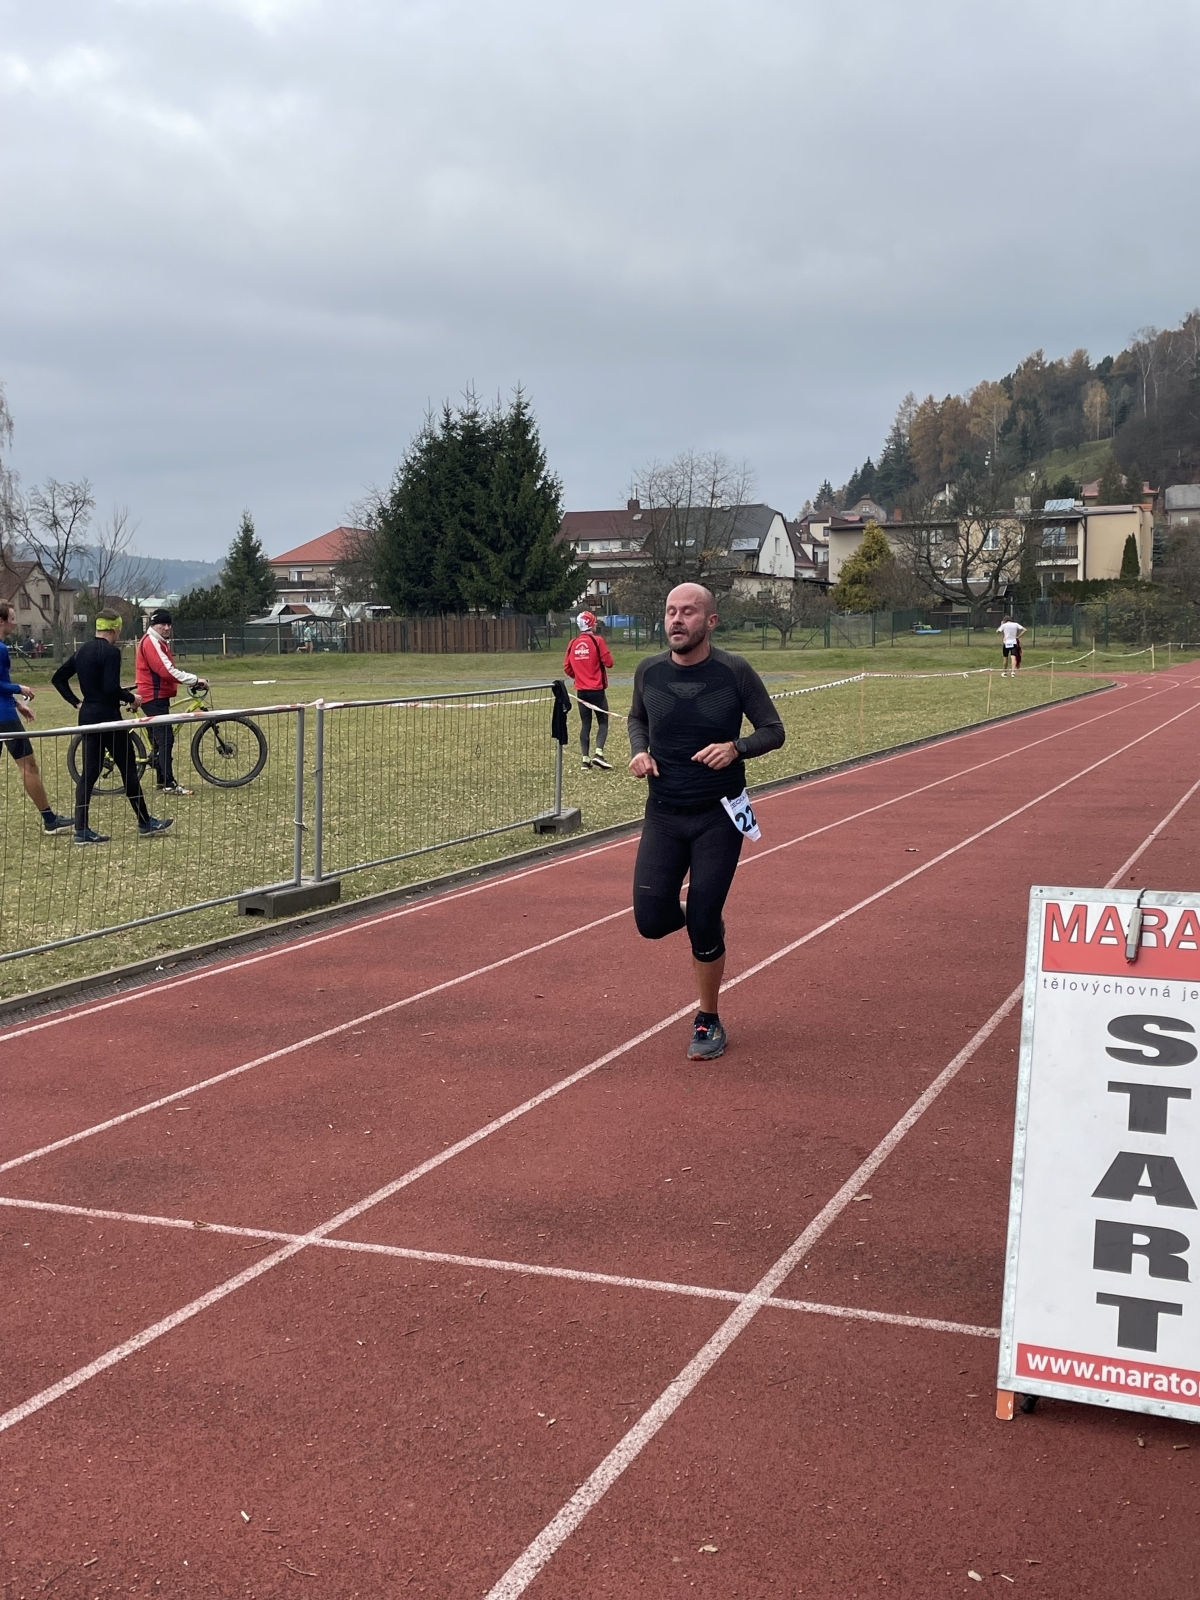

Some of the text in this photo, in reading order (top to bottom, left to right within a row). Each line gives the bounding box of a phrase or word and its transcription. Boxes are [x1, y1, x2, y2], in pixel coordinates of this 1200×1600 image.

[1045, 903, 1200, 950] MARA
[1043, 977, 1200, 1002] tělovýchovná je
[1091, 1014, 1199, 1353] START
[1026, 1352, 1200, 1398] www.marato
